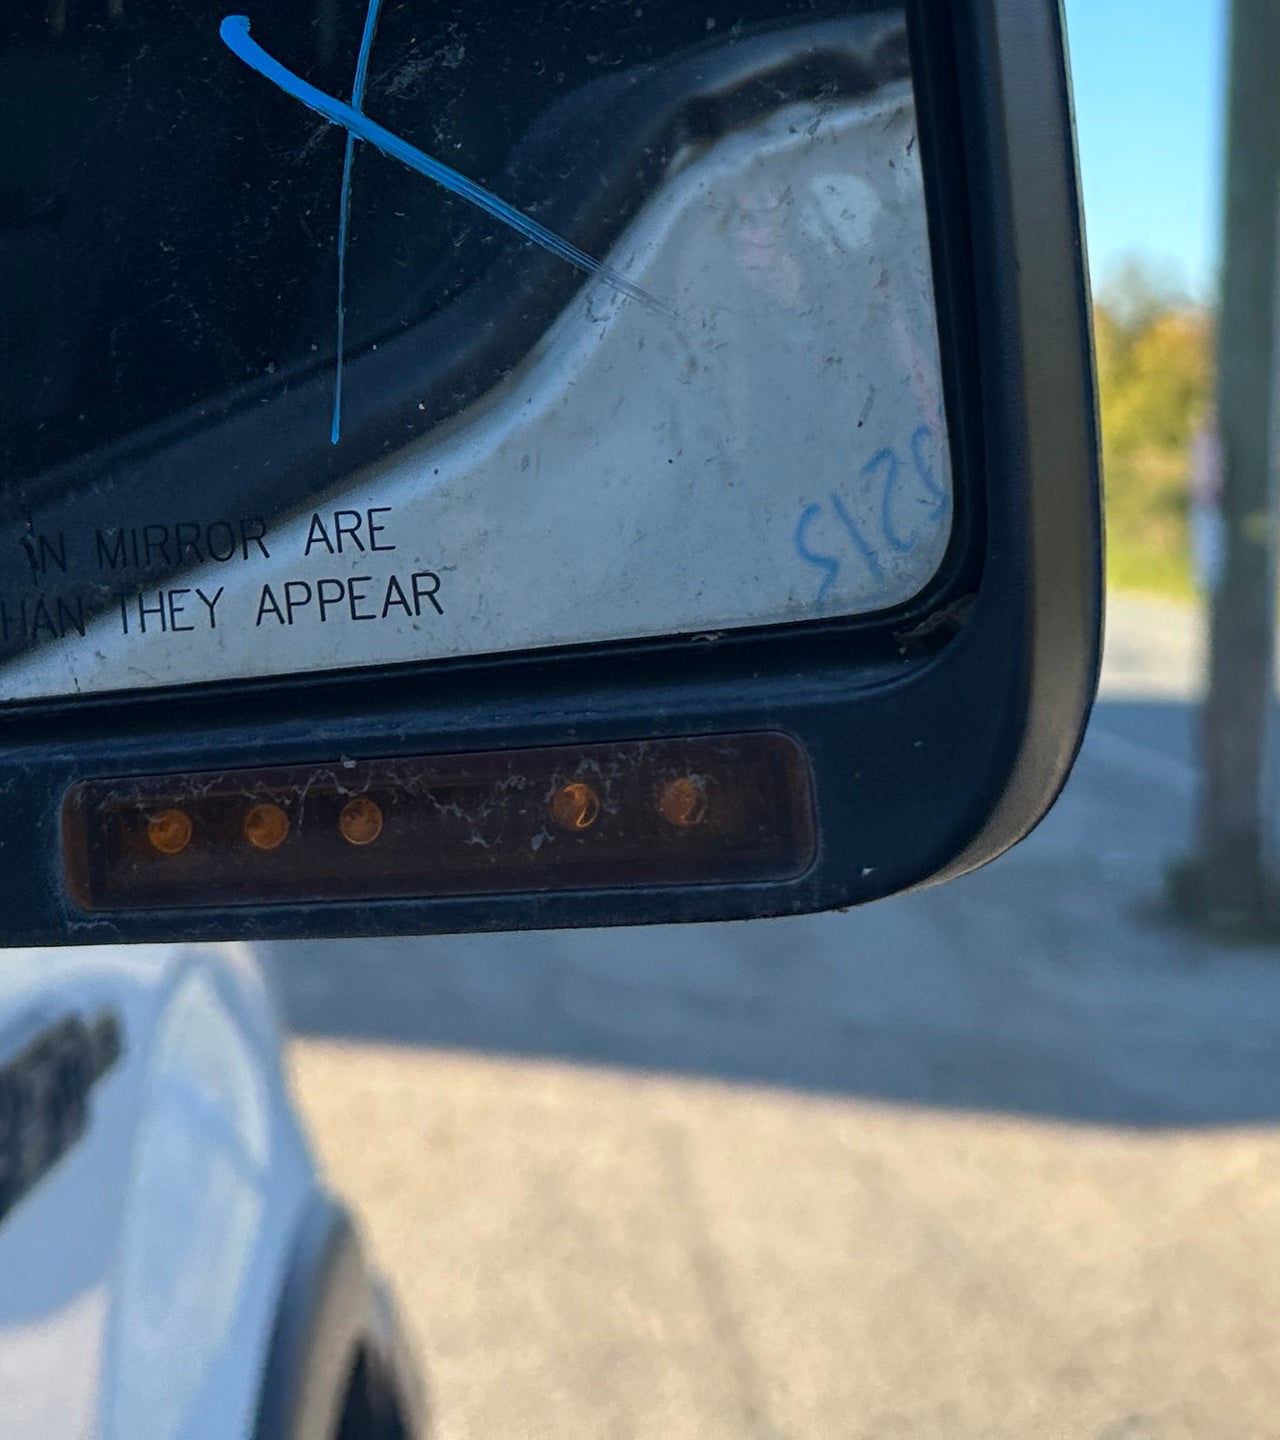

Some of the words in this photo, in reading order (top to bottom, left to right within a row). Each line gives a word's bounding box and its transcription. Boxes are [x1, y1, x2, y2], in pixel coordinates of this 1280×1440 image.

[24, 530, 68, 574] IN
[95, 514, 271, 567] MIRROR
[304, 507, 397, 556] ARE
[114, 586, 225, 636] THEY
[255, 571, 445, 627] APPEAR
